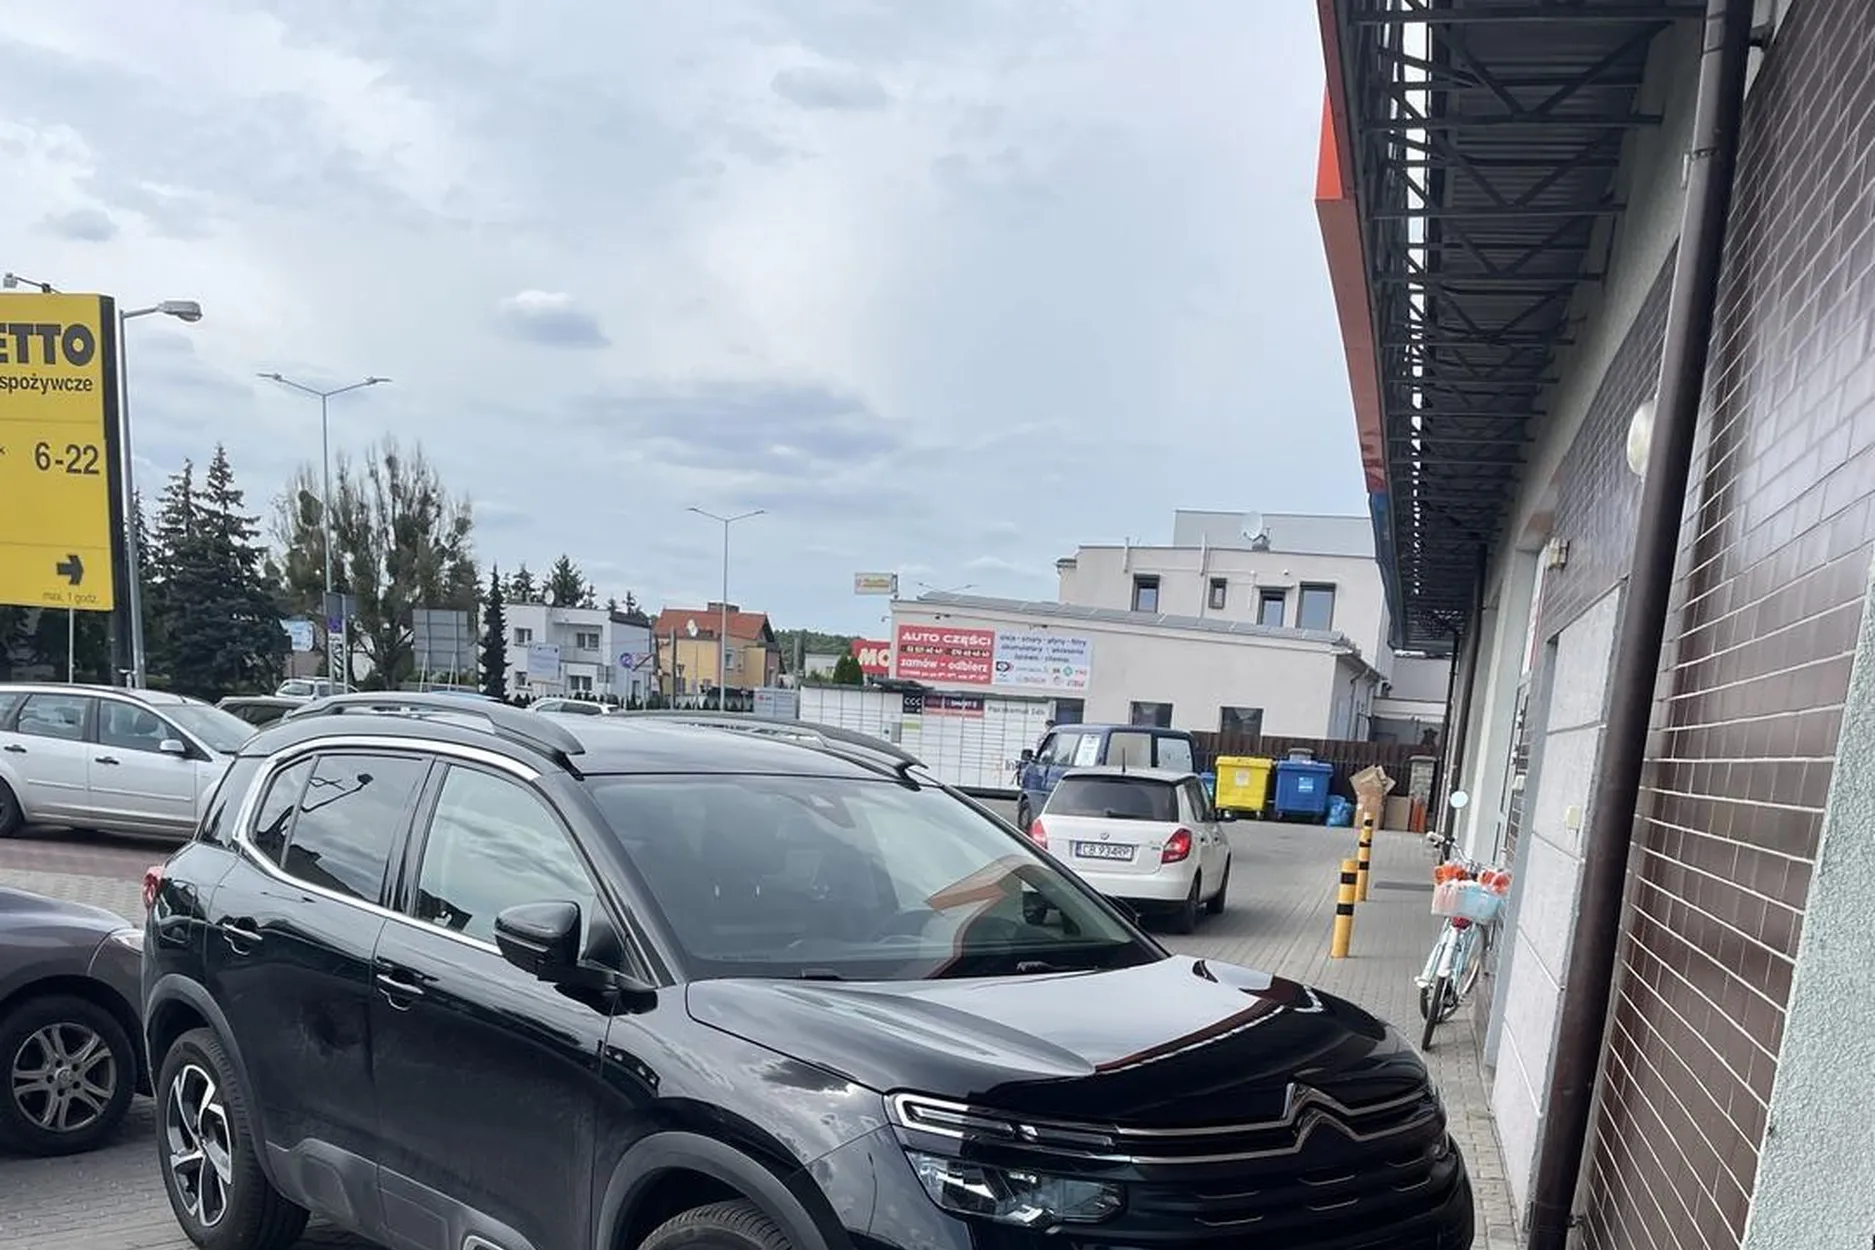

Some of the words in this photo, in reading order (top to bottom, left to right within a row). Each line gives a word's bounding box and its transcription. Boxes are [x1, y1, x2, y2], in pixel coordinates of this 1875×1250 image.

[902, 632, 940, 642] AUTO
[942, 634, 991, 647] CZĘŚCI
[900, 658, 938, 668] zamów
[947, 660, 988, 672] odbierz
[904, 697, 921, 706] CCC
